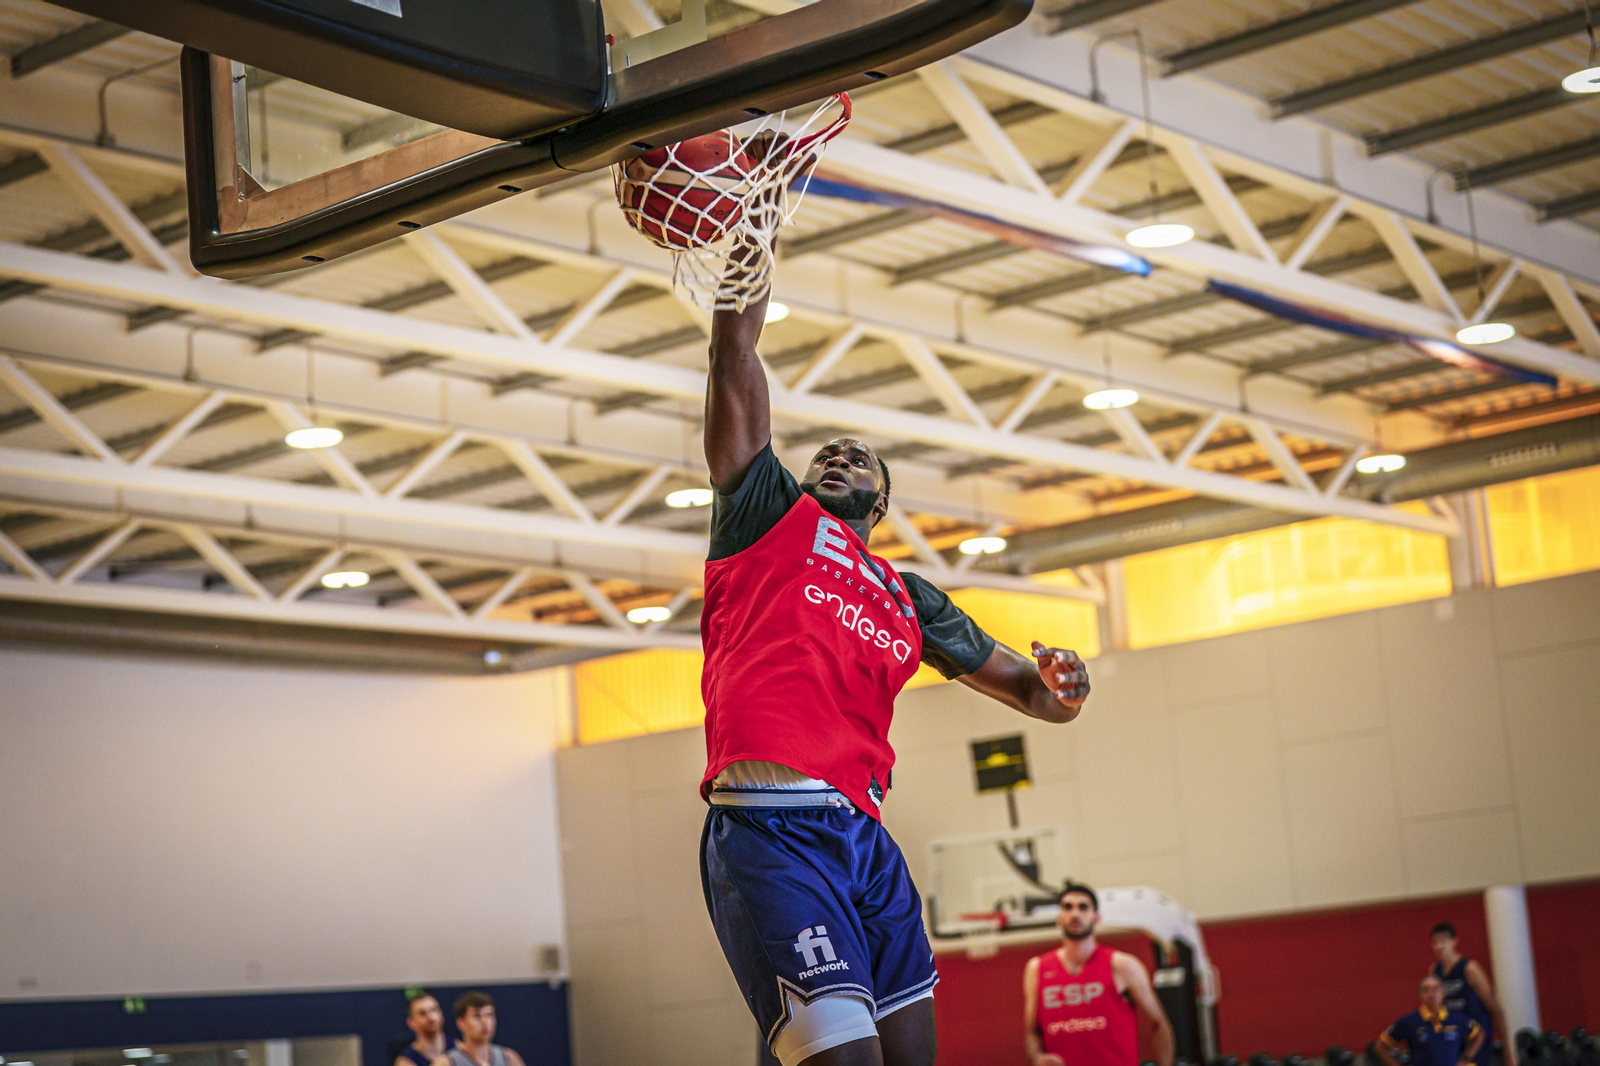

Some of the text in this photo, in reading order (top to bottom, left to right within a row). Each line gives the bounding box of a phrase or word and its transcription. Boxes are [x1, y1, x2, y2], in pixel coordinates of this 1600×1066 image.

[806, 558, 911, 628] BASKETBA
[804, 584, 912, 665] endesa
[794, 925, 837, 968] fi
[798, 959, 850, 981] network
[1043, 982, 1104, 1009] ESP
